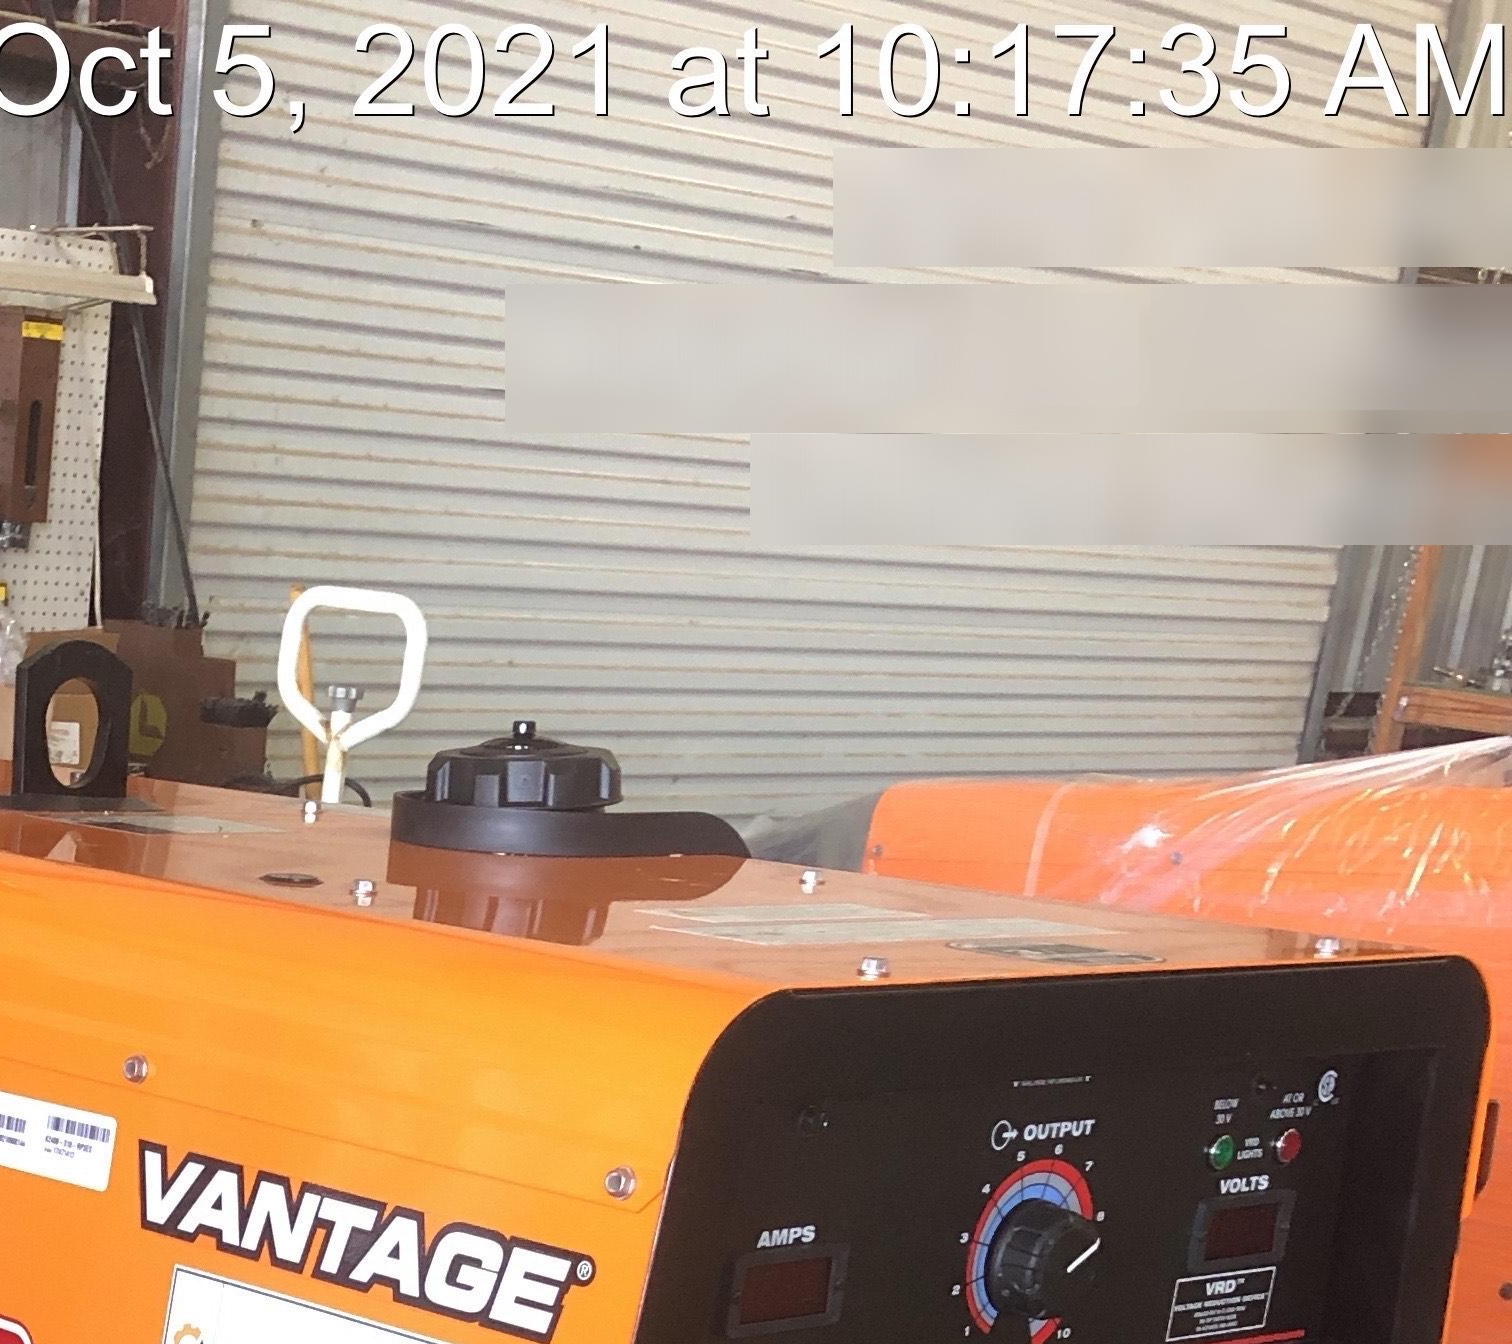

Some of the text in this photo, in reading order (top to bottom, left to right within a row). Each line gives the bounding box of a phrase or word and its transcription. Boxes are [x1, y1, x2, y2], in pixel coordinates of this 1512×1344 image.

[1022, 1118, 1096, 1142] OUTPUT
[1054, 1143, 1063, 1155] 6
[1016, 1150, 1026, 1161] 5
[1085, 1160, 1095, 1172] 7
[980, 1183, 991, 1195] 4
[1219, 1174, 1270, 1195] VOLTS
[756, 1224, 817, 1249] AMPS
[959, 1232, 969, 1243] 3
[951, 1285, 961, 1296] 2
[964, 1325, 971, 1337] 1
[1056, 1326, 1071, 1340] 10
